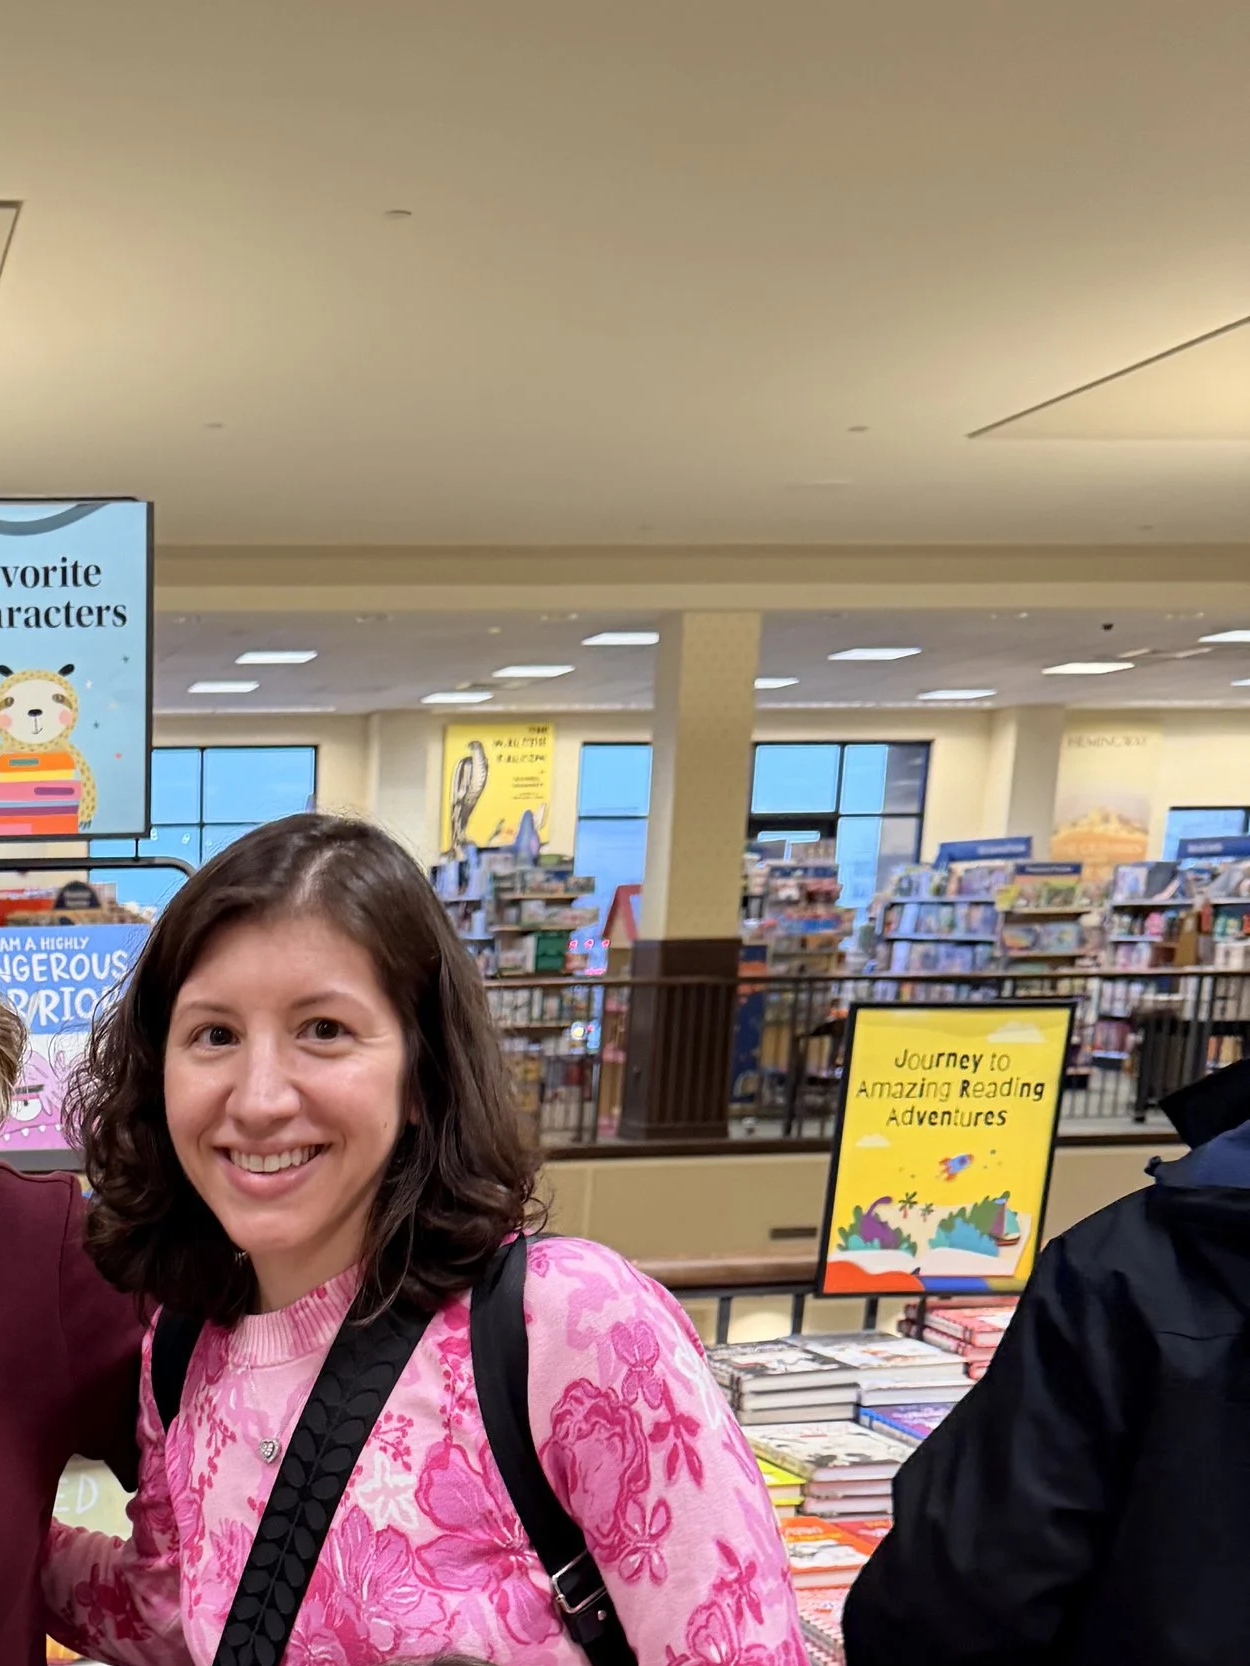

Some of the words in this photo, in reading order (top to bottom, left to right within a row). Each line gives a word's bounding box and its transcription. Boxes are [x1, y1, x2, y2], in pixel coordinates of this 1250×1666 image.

[0, 937, 21, 952] AM
[24, 937, 37, 951] A
[40, 936, 90, 950] HIGHLY
[894, 1049, 983, 1074] Journey
[990, 1052, 1010, 1071] to
[855, 1077, 952, 1102] Amazing
[959, 1077, 1046, 1102] Reading
[886, 1107, 1008, 1128] Adventures
